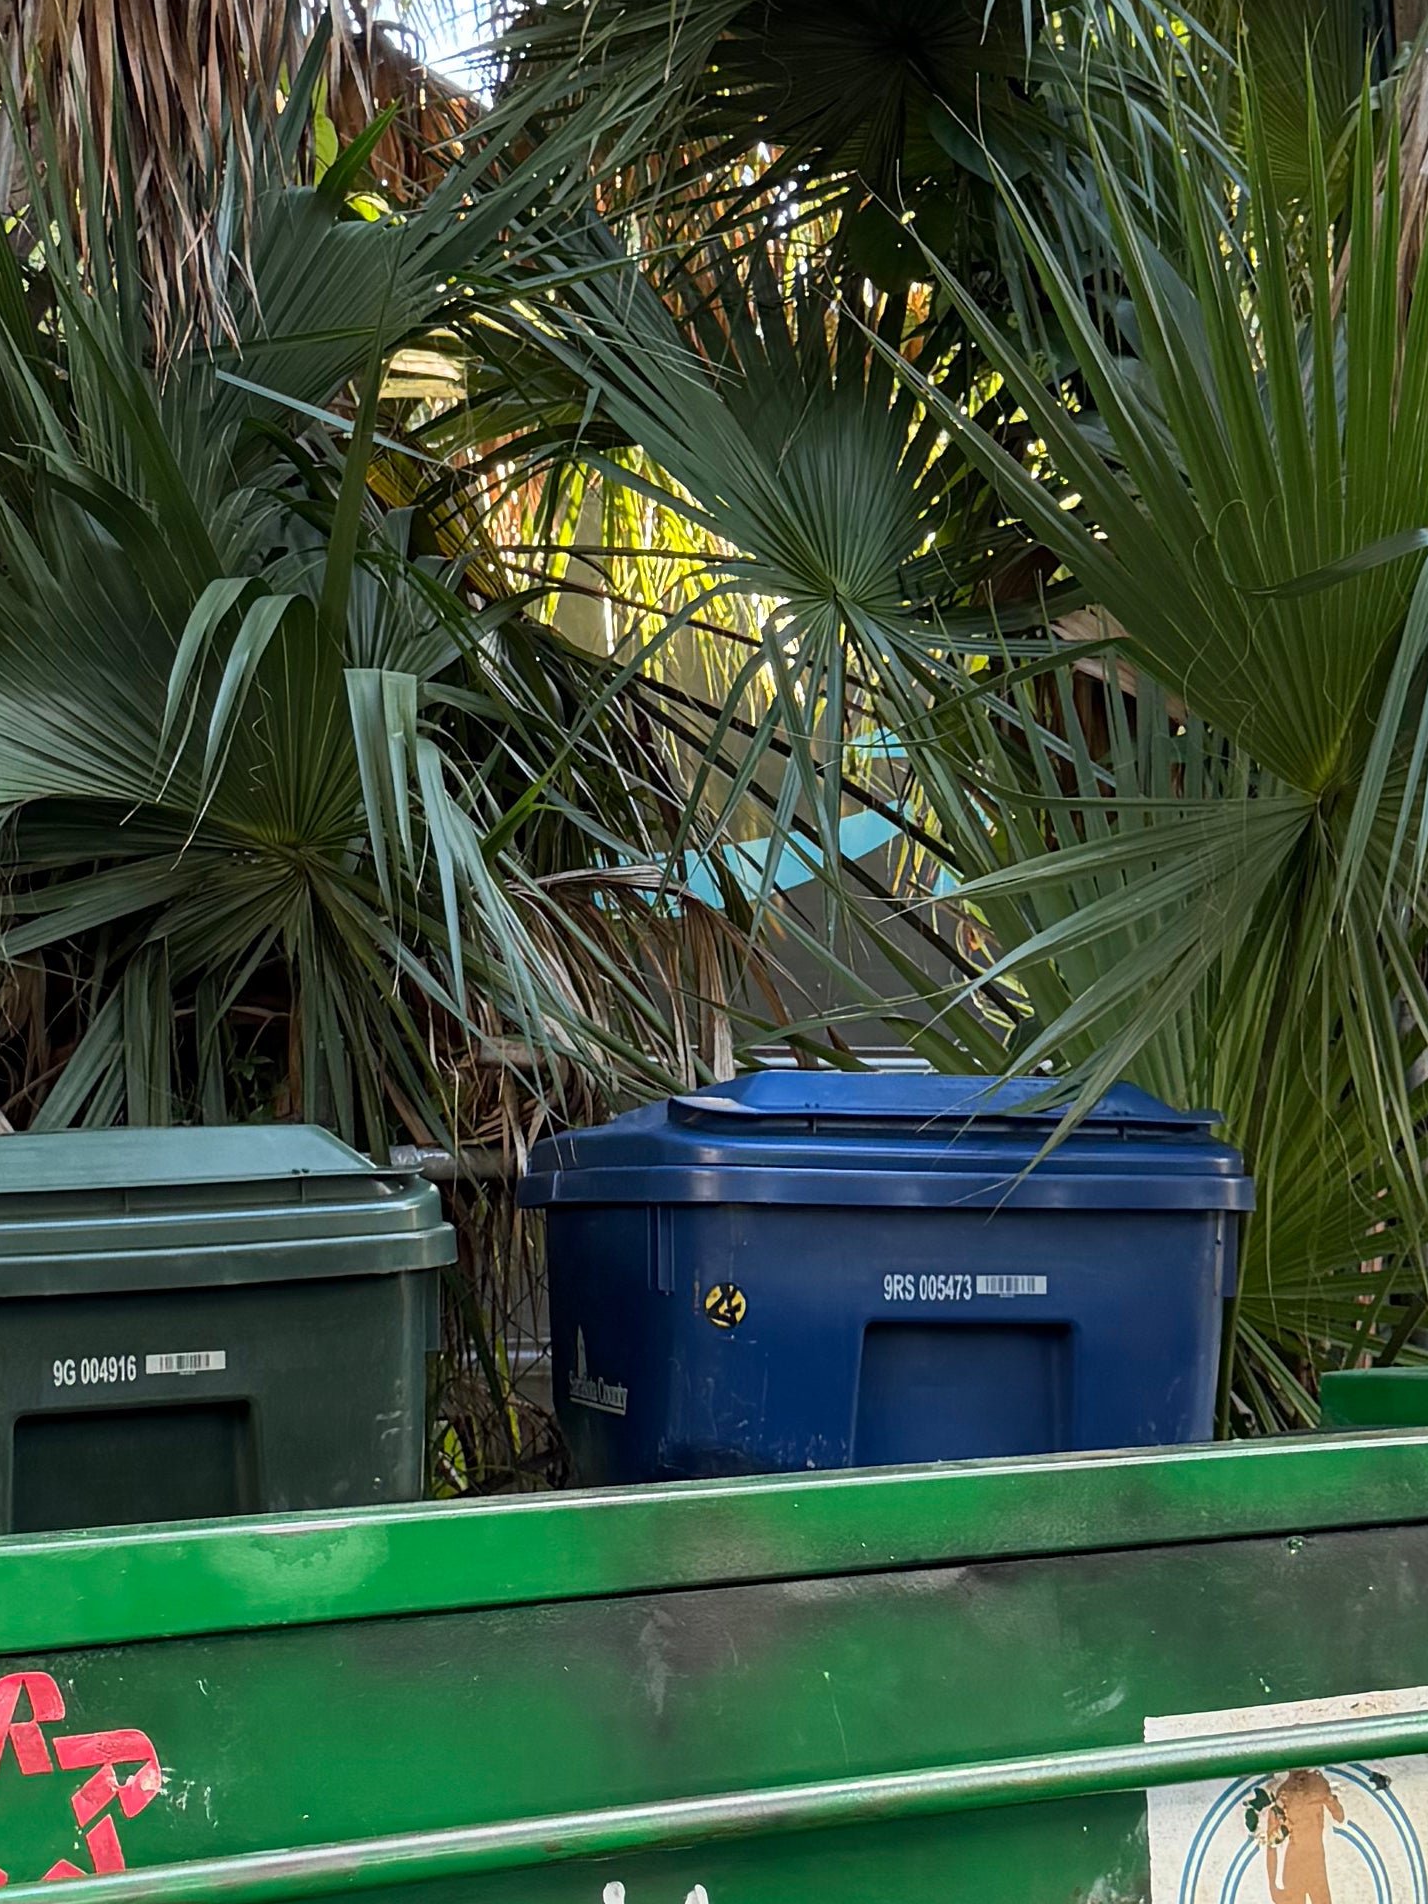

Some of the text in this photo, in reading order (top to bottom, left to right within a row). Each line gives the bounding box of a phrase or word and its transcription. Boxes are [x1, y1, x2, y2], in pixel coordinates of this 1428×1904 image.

[883, 1274, 972, 1301] 9RS 005473
[53, 1354, 136, 1386] 9G 004916
